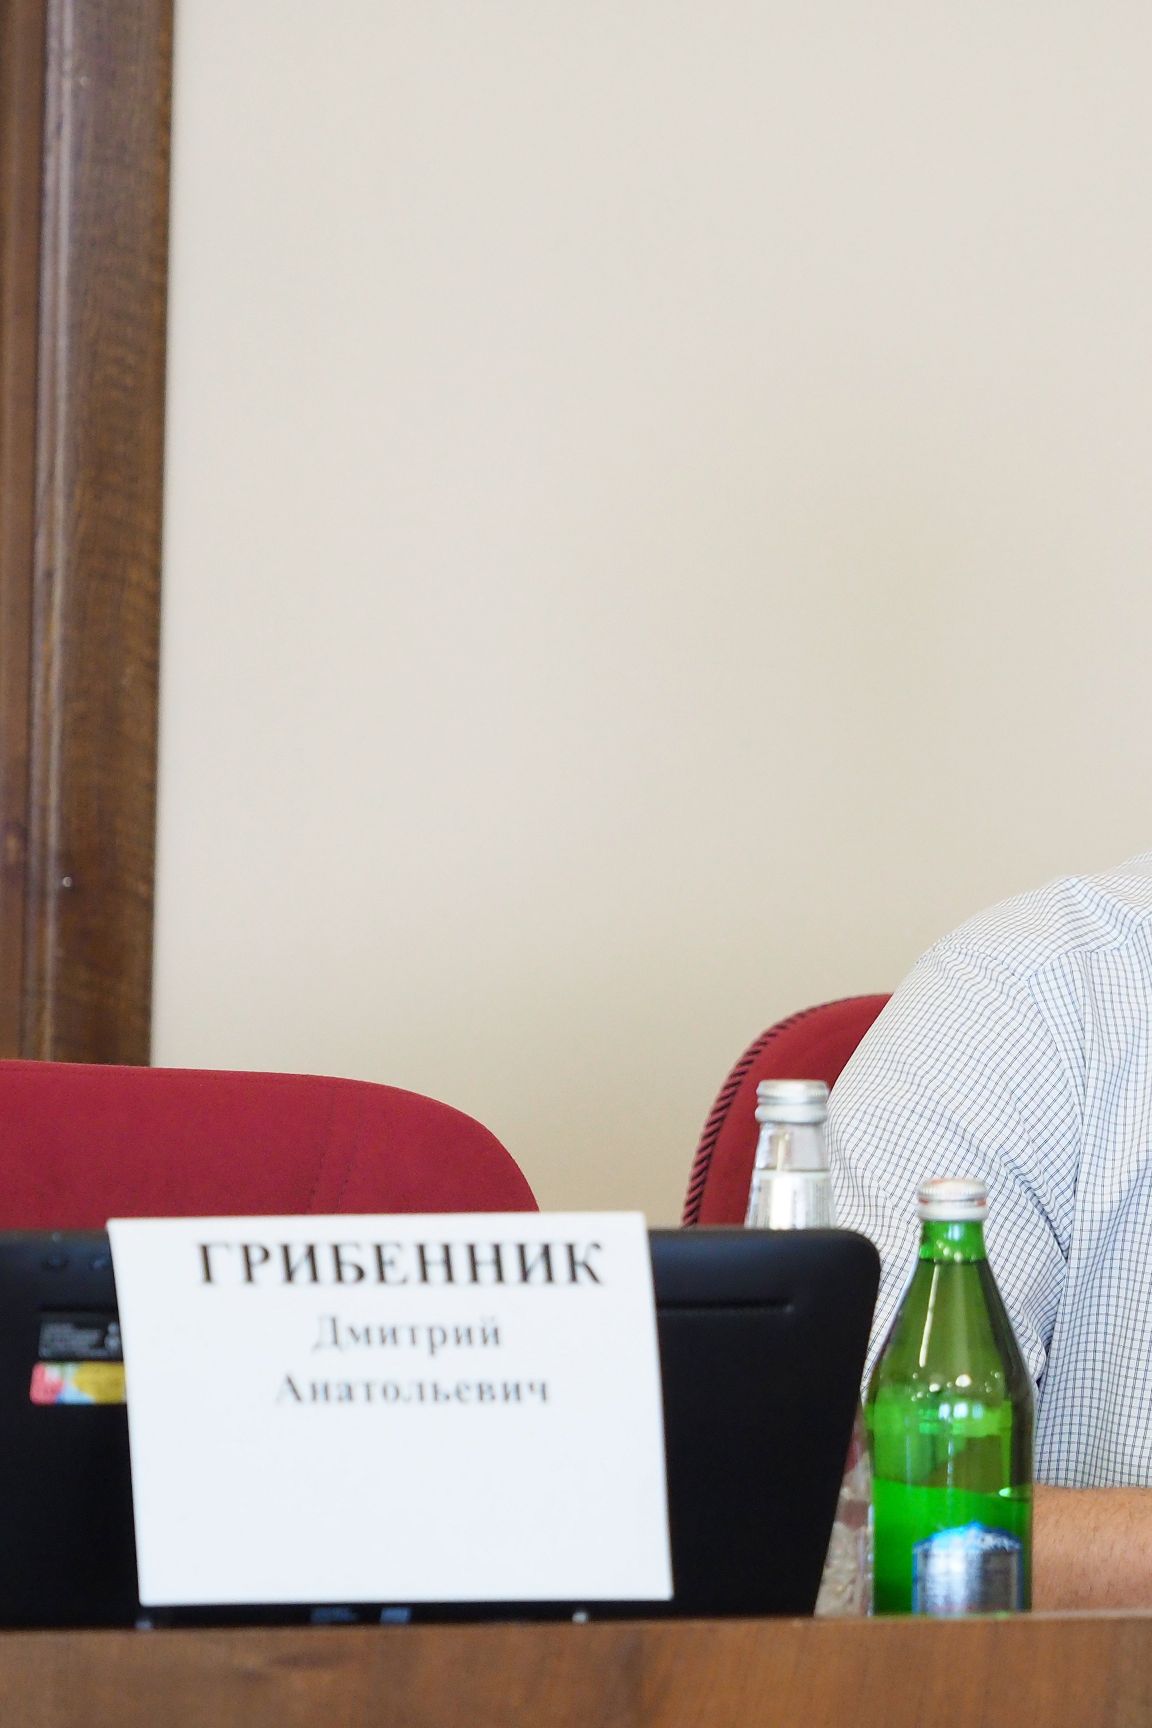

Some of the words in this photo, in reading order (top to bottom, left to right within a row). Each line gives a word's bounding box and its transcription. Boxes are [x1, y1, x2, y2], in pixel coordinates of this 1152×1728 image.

[196, 1240, 605, 1287] ГРИБЕННИК
[311, 1313, 502, 1356] Дмитрий
[276, 1373, 549, 1405] Анатольевич
